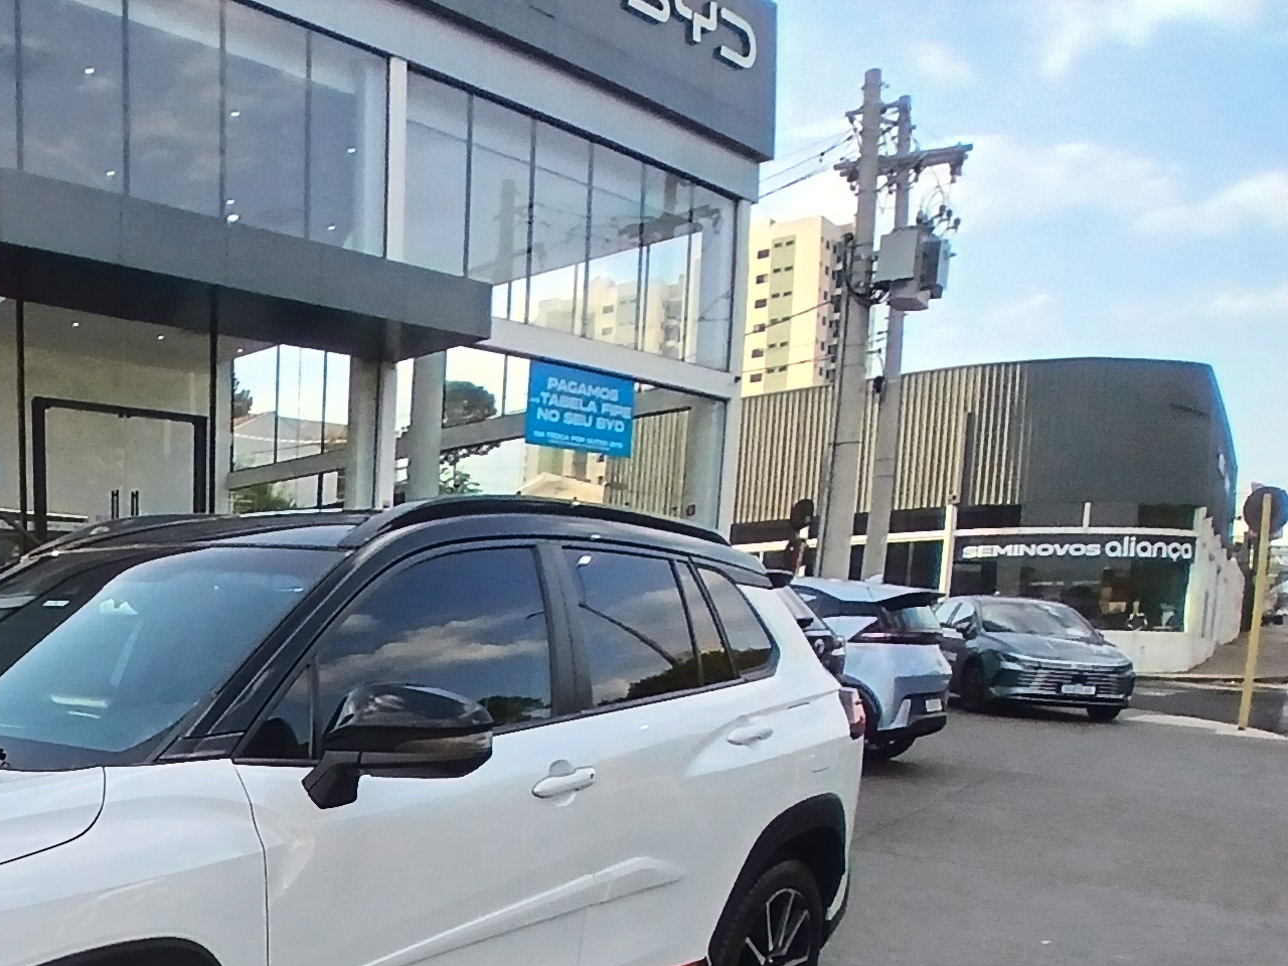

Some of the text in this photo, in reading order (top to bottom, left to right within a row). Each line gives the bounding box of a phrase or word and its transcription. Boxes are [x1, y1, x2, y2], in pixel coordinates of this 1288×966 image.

[540, 391, 597, 413] TABELA
[546, 376, 619, 402] PAGAMOS
[536, 407, 625, 433] NO SEU BYD
[962, 536, 1192, 562] SEMINOVOS aliança
